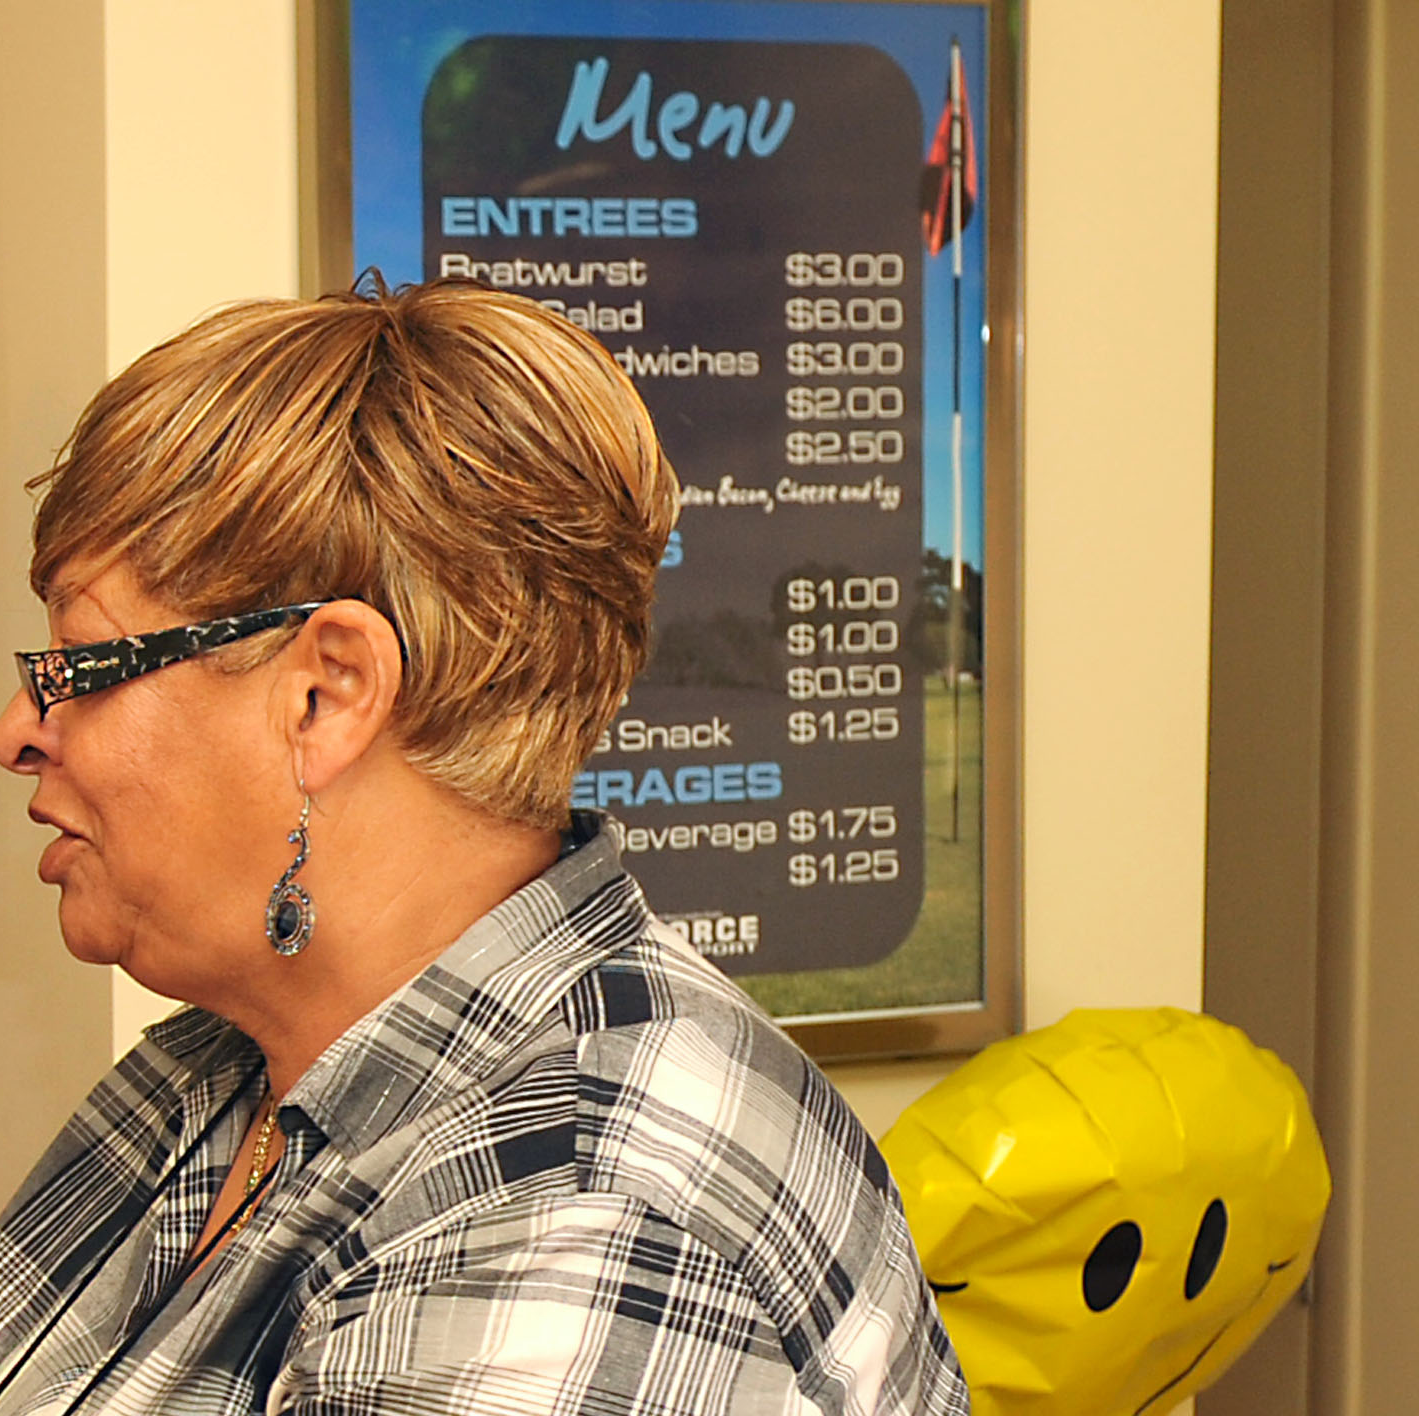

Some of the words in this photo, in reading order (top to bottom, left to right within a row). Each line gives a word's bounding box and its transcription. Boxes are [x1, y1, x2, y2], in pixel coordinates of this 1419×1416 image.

[555, 56, 795, 161] Menu
[440, 196, 698, 238] ENTREES
[440, 253, 648, 287] Bratwurst
[785, 252, 904, 287] $3.00
[785, 297, 904, 332] $6.00
[613, 345, 761, 377] dwiches
[785, 341, 904, 376] $3.00
[785, 386, 904, 421] $2.00
[785, 430, 904, 465] $2.50
[776, 475, 838, 504] Cheese
[839, 480, 873, 502] and
[874, 474, 902, 511] Egg
[786, 575, 899, 612] $1.00
[786, 620, 899, 656] $1.00
[787, 663, 902, 700] $0.50
[618, 716, 733, 752] Snack
[787, 707, 899, 744] $1.25
[570, 762, 783, 808] ERAGES
[787, 805, 897, 843] $1.75
[788, 849, 899, 886] $1.25
